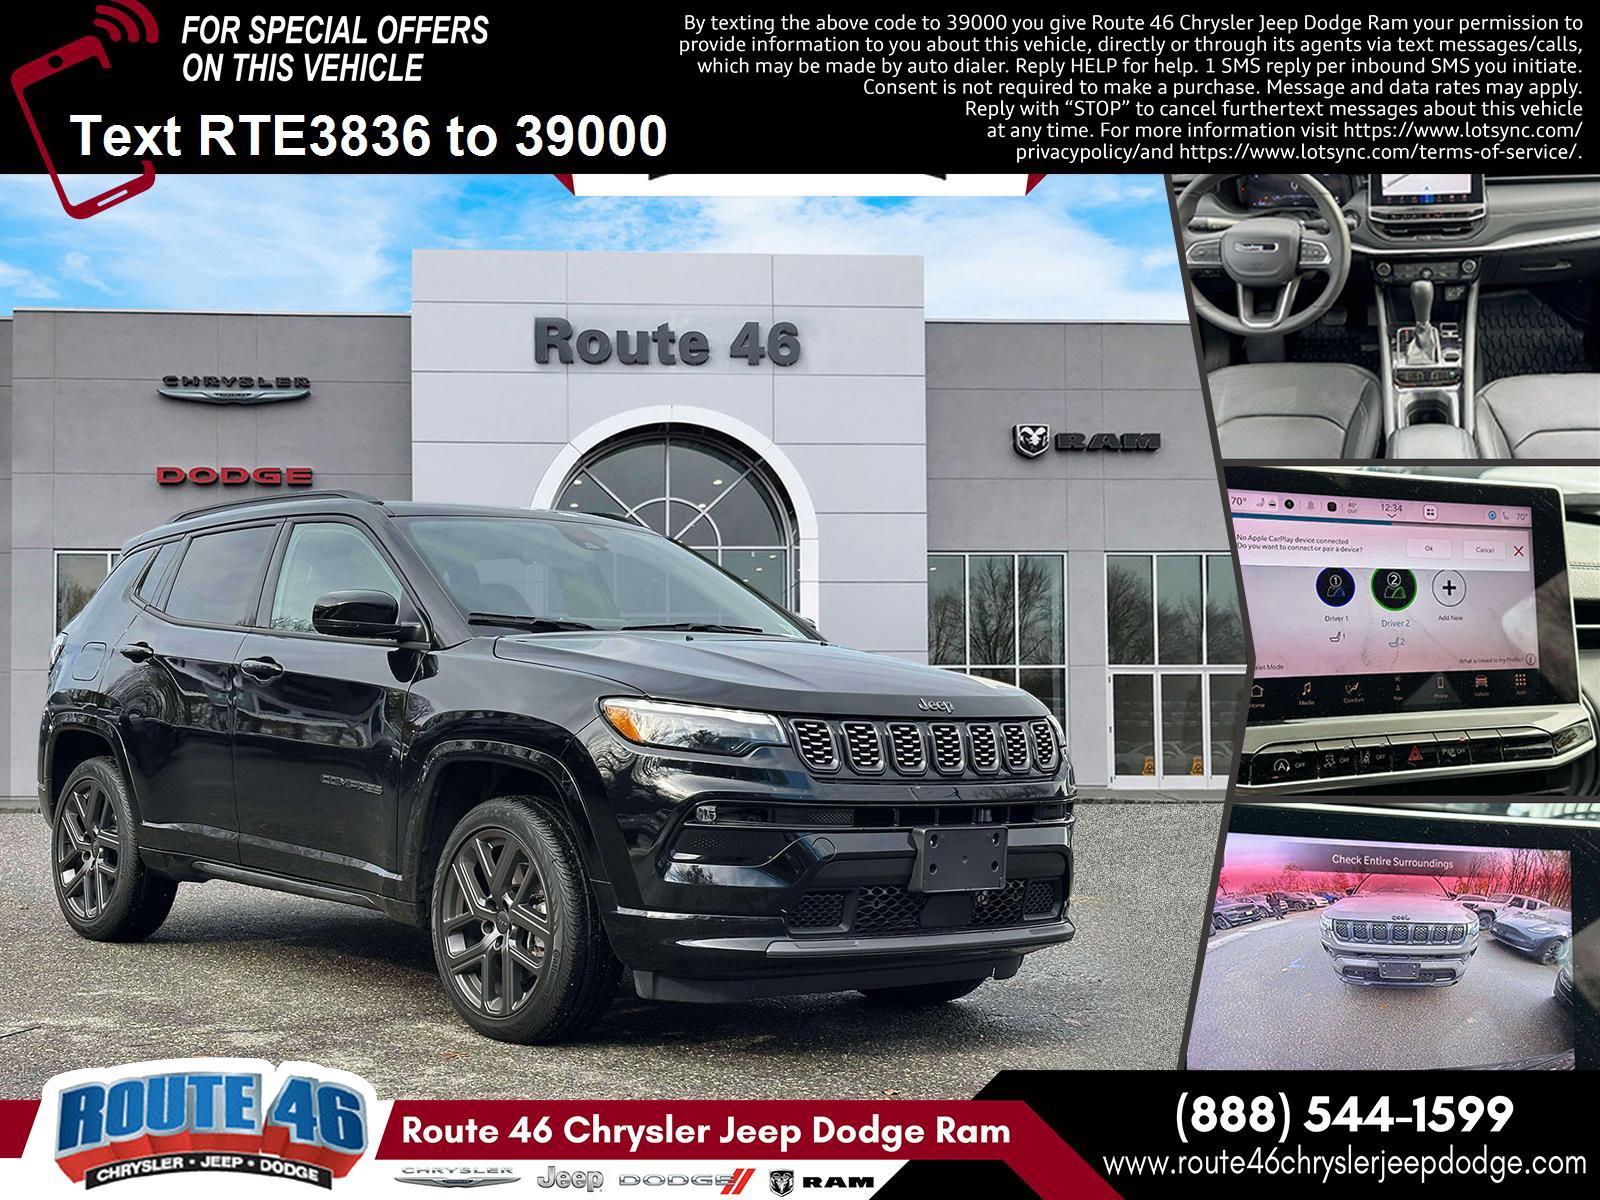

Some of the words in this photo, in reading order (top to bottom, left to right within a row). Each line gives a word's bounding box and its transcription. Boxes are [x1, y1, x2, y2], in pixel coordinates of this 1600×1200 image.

[534, 317, 710, 365] Route
[730, 321, 801, 367] 46
[161, 375, 311, 388] CHRYSLER
[1054, 432, 1162, 452] RAM
[156, 466, 313, 487] DODGE
[1381, 503, 1402, 512] 12:34
[1268, 536, 1294, 544] CarPlay
[918, 698, 954, 714] Jeep
[1332, 854, 1362, 864] Check
[1364, 856, 1392, 866] Entire
[1393, 857, 1454, 870] Surroundings
